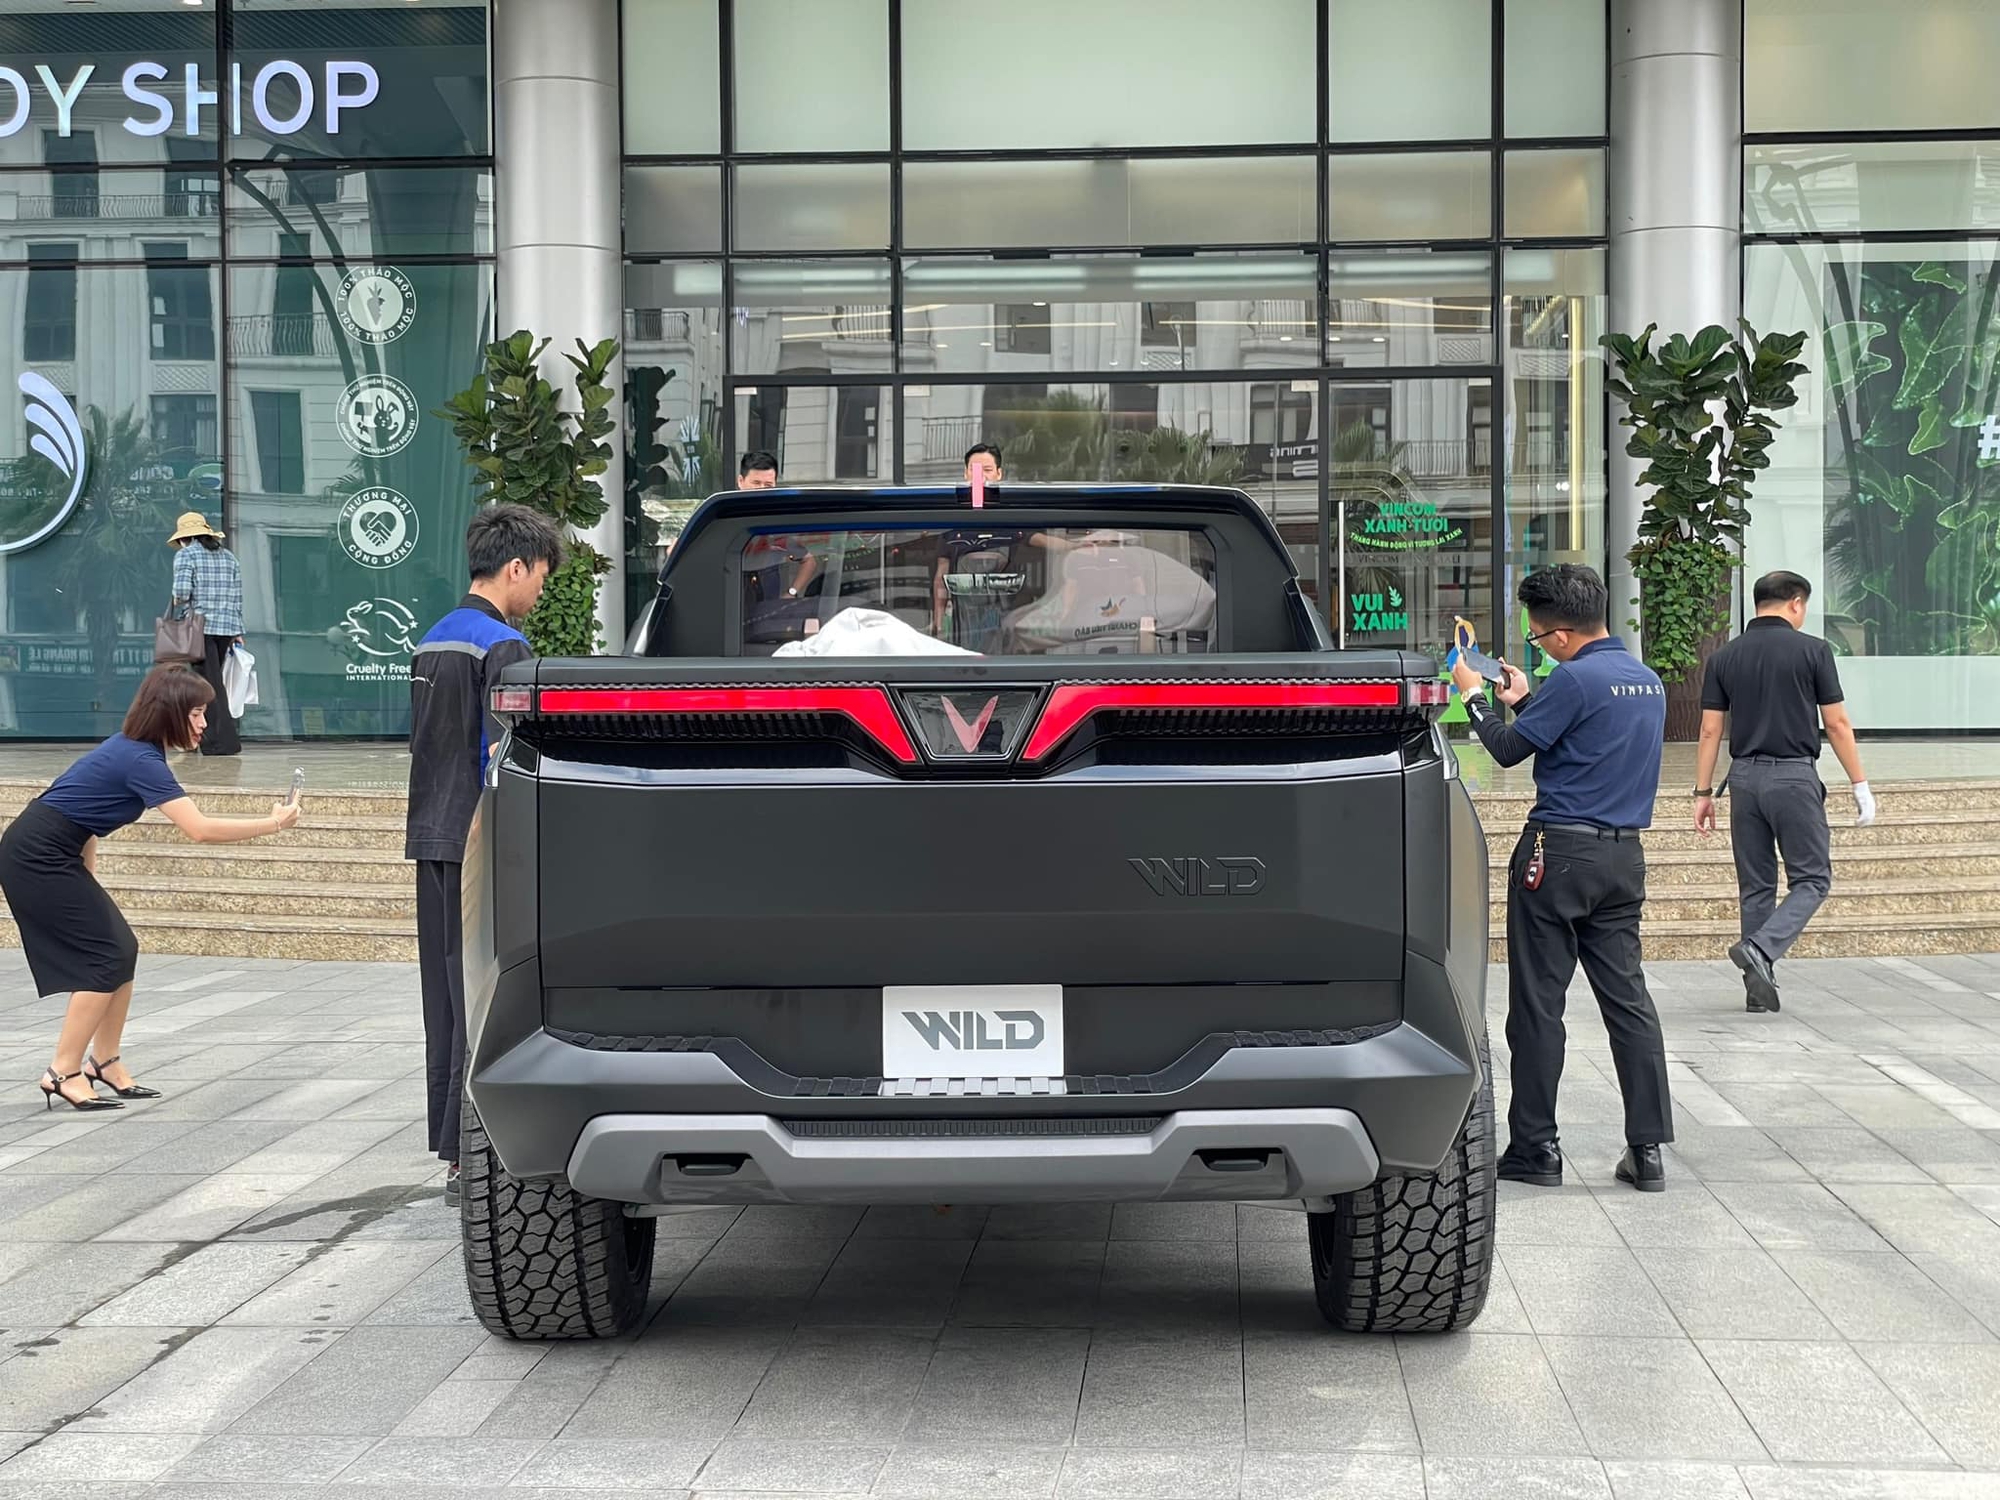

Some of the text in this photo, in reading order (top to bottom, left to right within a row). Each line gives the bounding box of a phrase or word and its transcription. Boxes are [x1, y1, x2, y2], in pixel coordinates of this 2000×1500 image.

[121, 60, 380, 136] SHOP
[337, 273, 358, 301] 100%
[339, 310, 362, 337] 100%
[1379, 502, 1437, 516] VINCOM
[1365, 519, 1407, 533] XANH
[1351, 594, 1384, 611] VUI
[1353, 612, 1409, 631] XANH
[346, 663, 386, 676] Cruelty
[1126, 857, 1266, 896] WILD
[901, 1010, 1044, 1050] WILD
